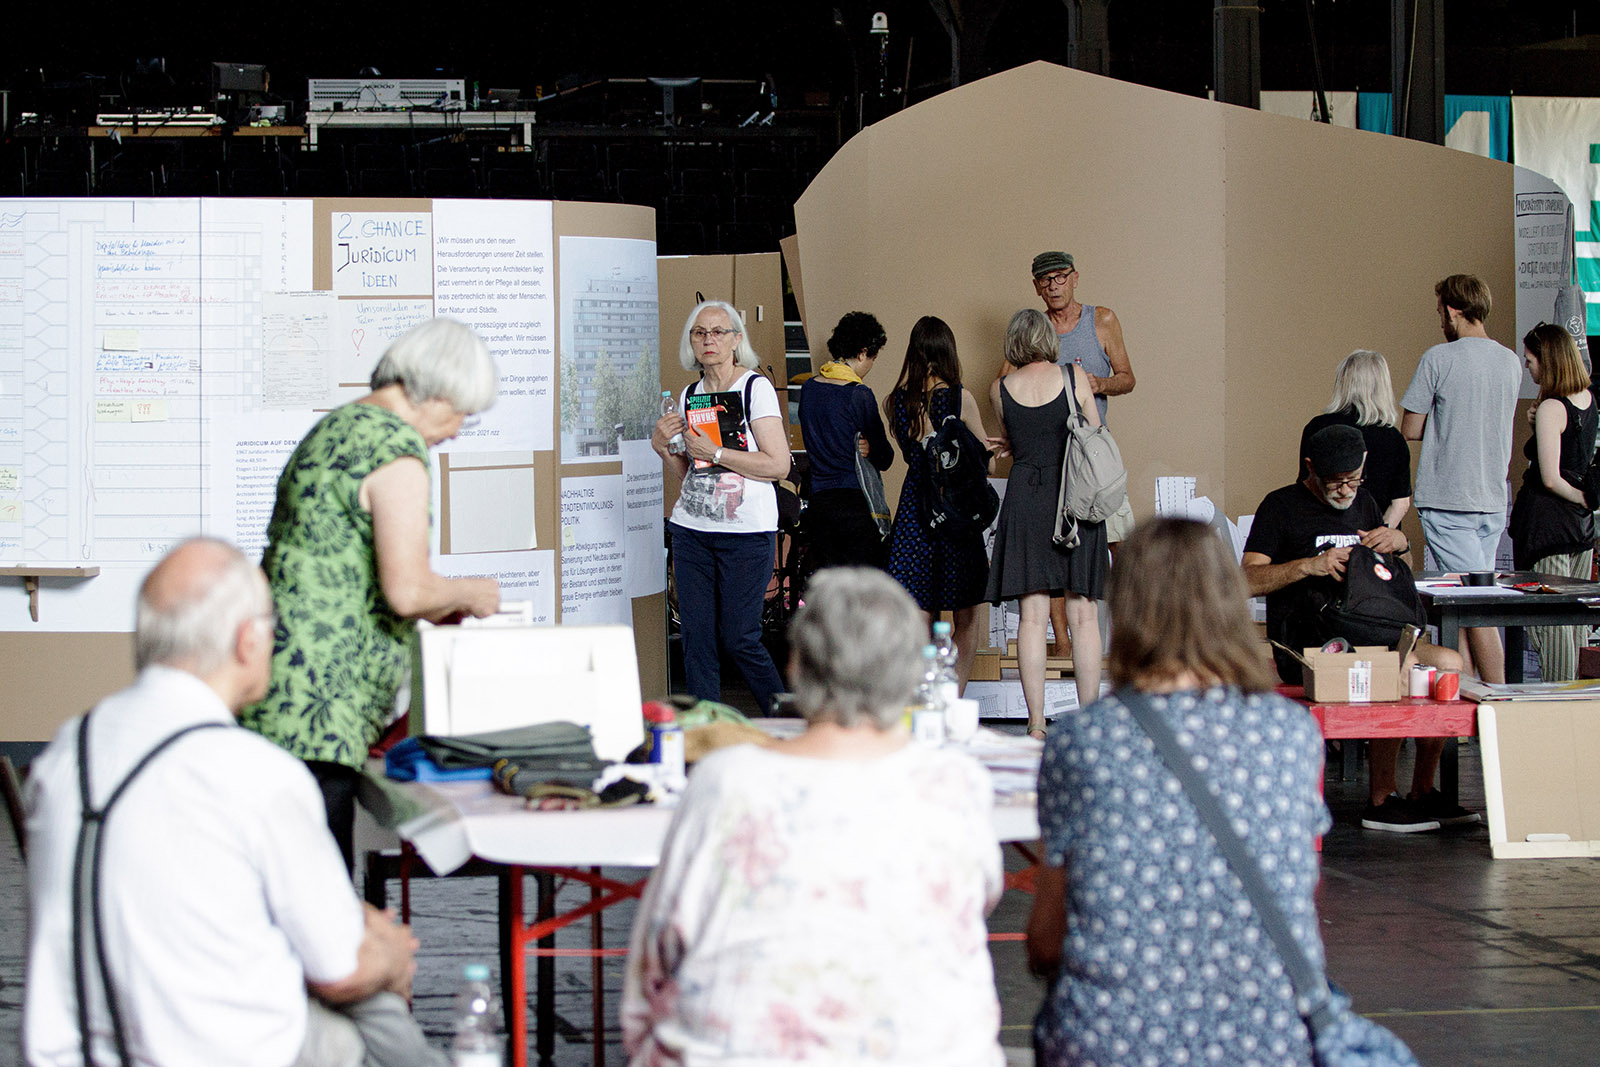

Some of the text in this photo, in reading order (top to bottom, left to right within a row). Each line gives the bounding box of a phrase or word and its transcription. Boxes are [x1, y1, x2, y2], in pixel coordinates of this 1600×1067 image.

[338, 214, 426, 239] 2. CHANCE
[437, 250, 492, 259] Herausforderungen
[449, 265, 490, 274] Verantwortung
[496, 279, 512, 287] Pflege
[474, 321, 507, 329] grosszügige
[520, 321, 541, 329] zugleich
[510, 375, 525, 383] Dinge
[526, 375, 548, 383] angehen
[561, 516, 580, 525] POLITIK
[569, 580, 588, 588] Bestand
[575, 592, 592, 601] Energie
